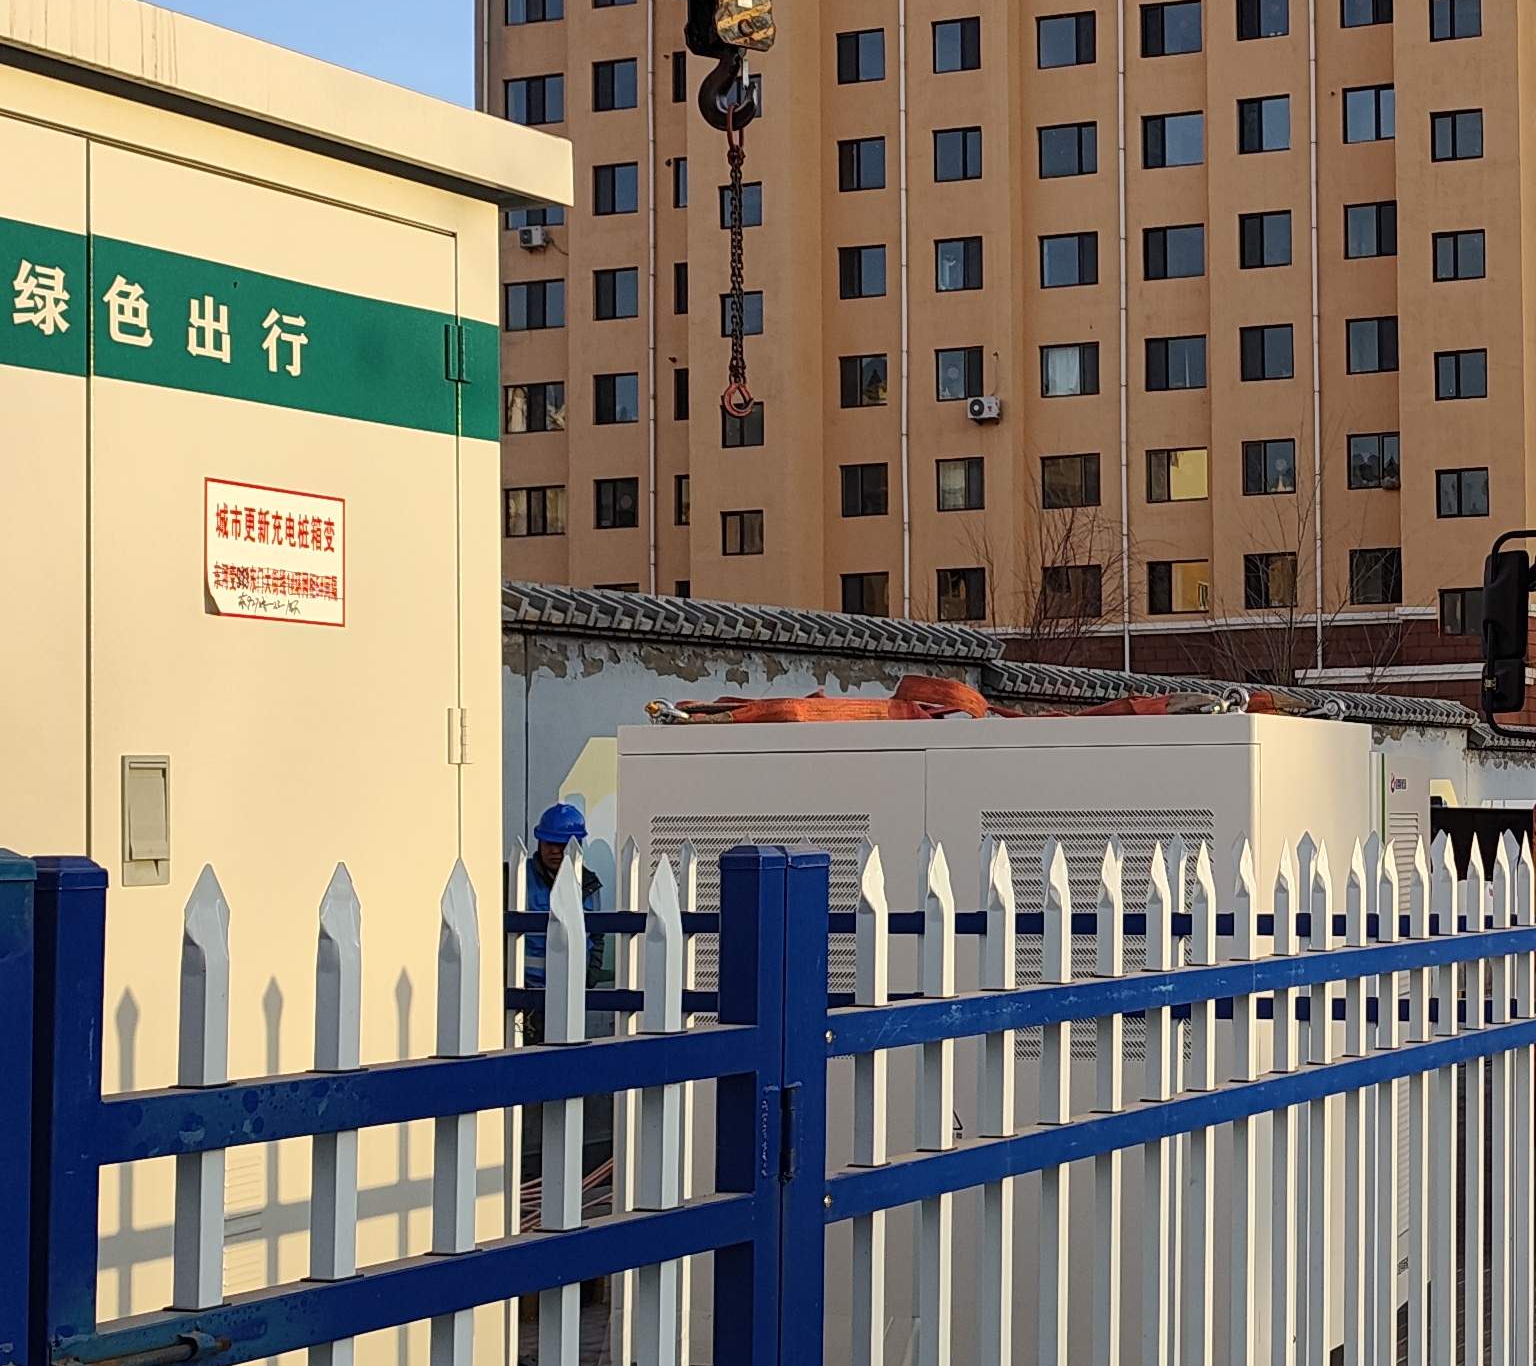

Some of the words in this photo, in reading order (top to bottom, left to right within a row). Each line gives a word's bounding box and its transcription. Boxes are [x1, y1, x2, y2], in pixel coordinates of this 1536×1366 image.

[12, 259, 309, 376] 绿色出行
[215, 502, 335, 553] 城市更新充电桩箱变
